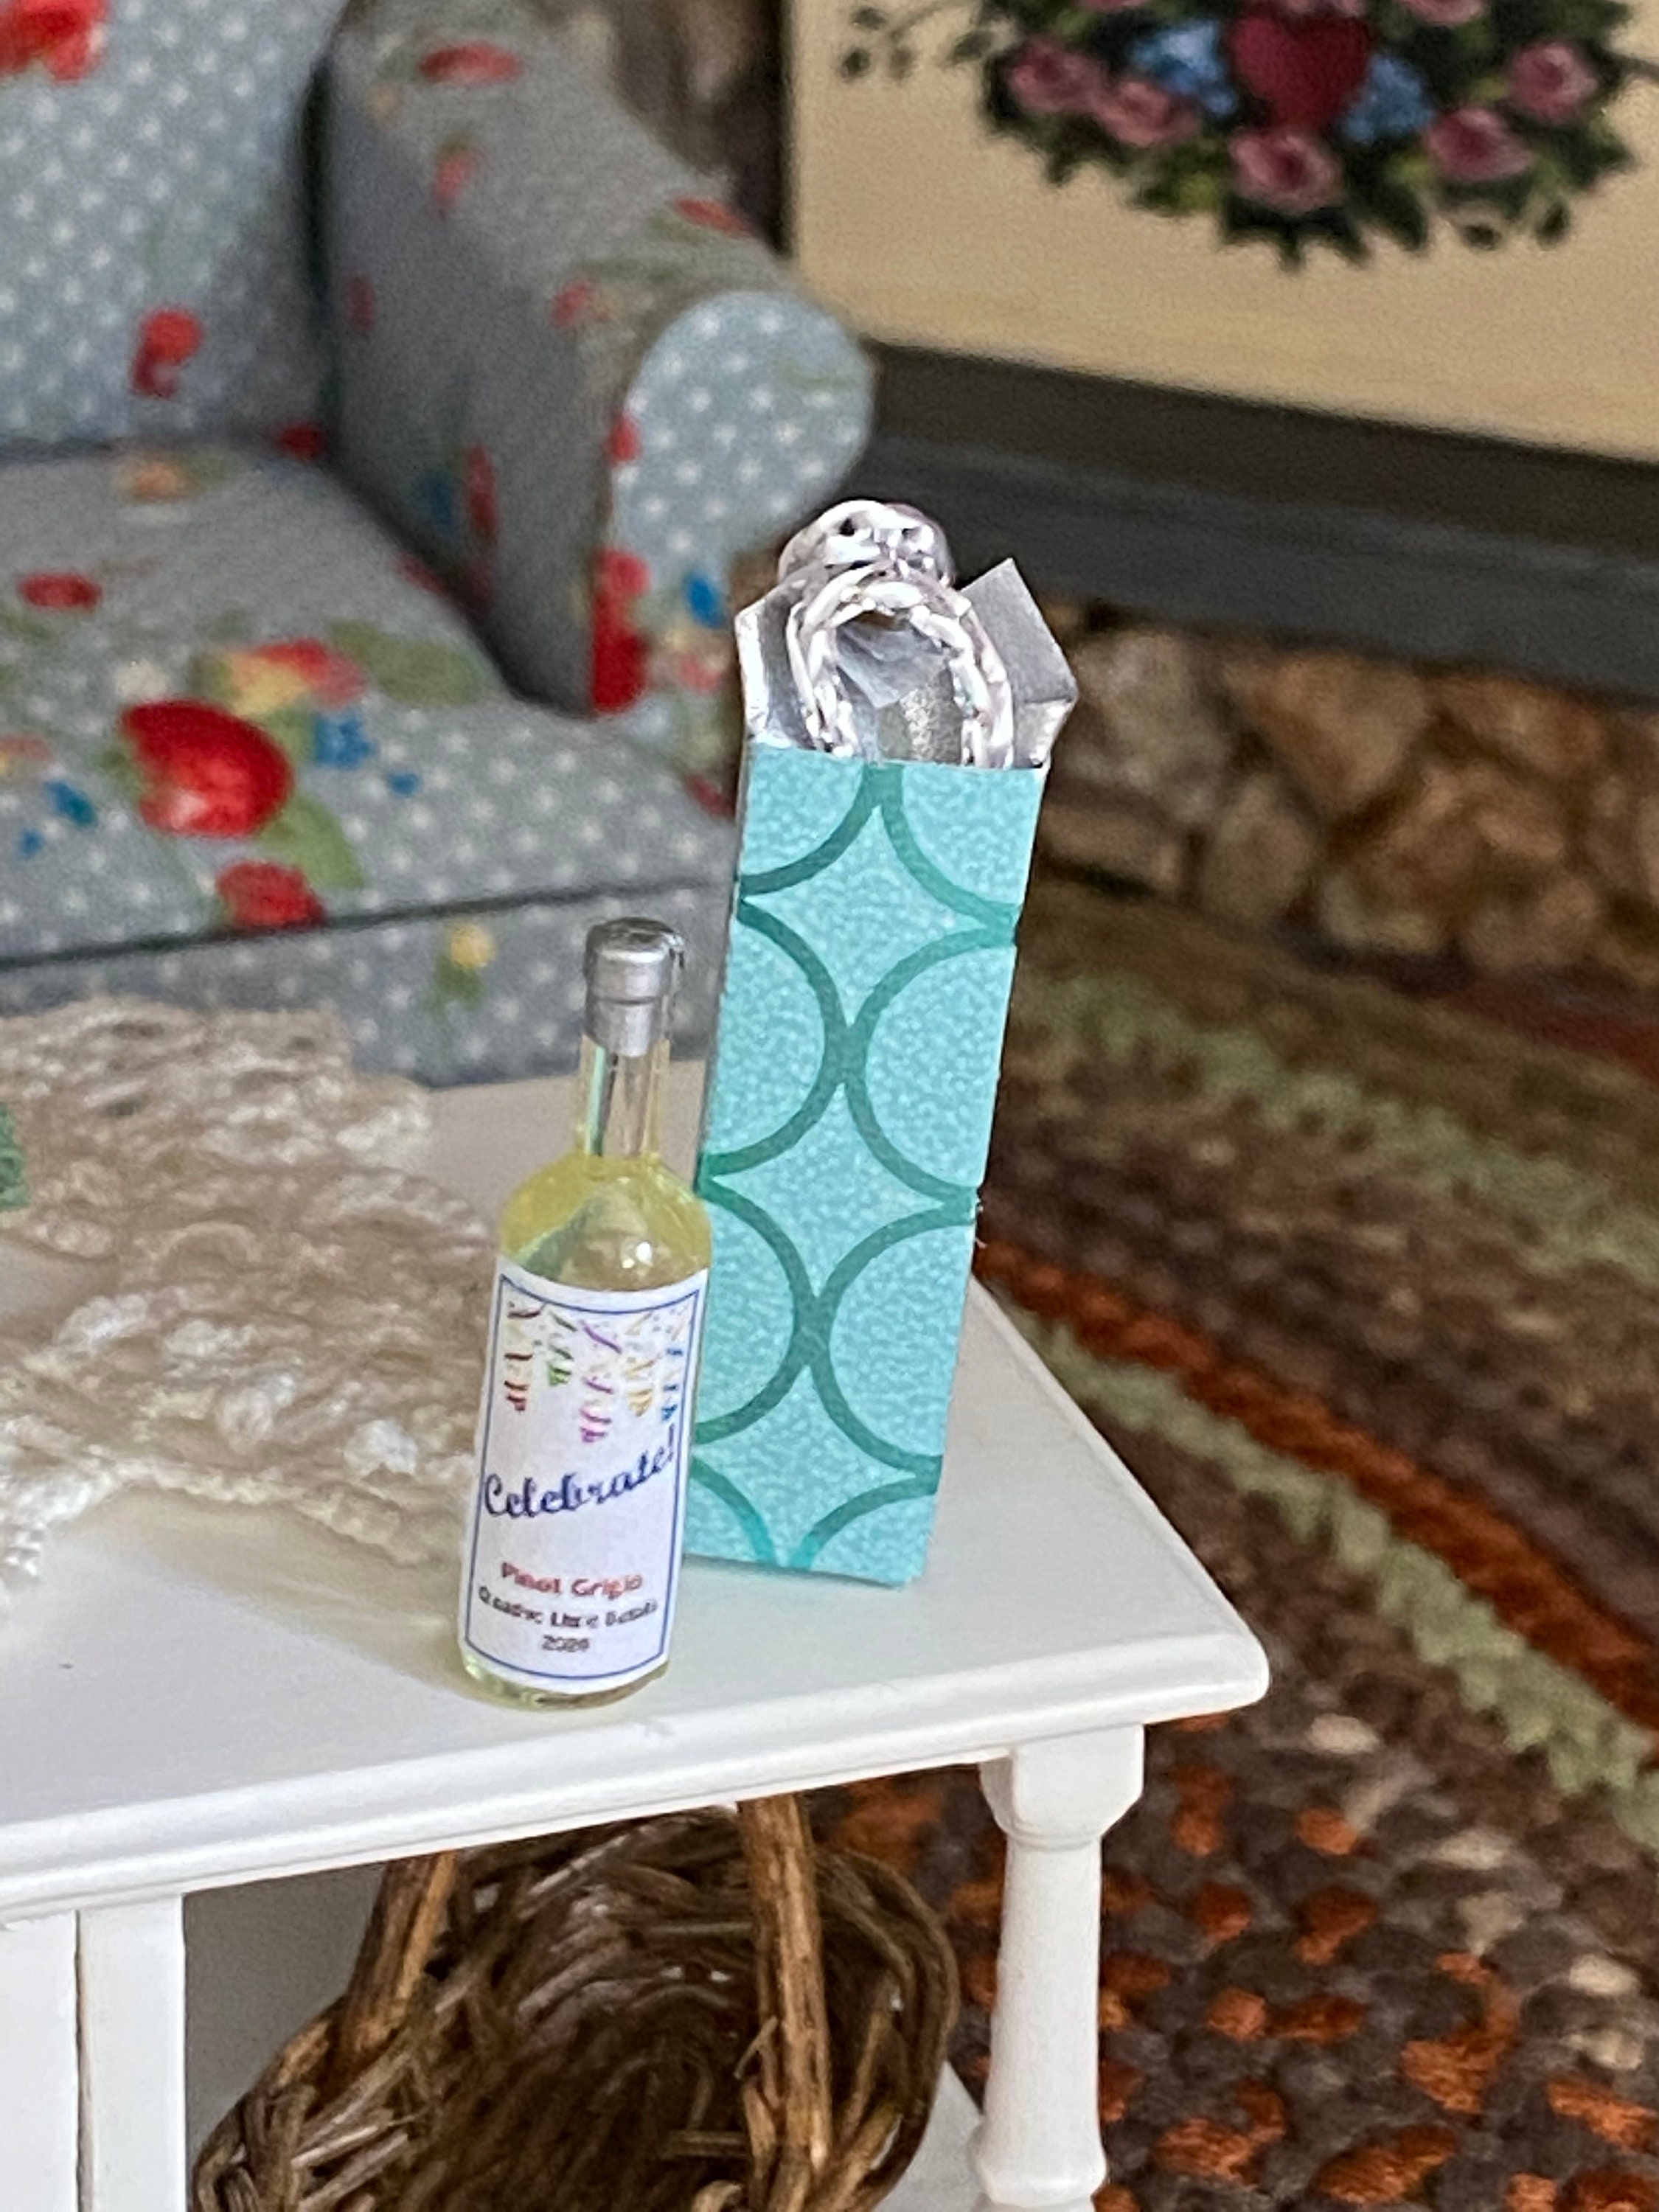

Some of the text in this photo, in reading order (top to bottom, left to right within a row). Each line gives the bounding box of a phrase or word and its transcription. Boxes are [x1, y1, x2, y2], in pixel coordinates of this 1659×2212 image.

[484, 1424, 675, 1518] Celebrate!
[501, 1562, 643, 1599] Pinot Grigio
